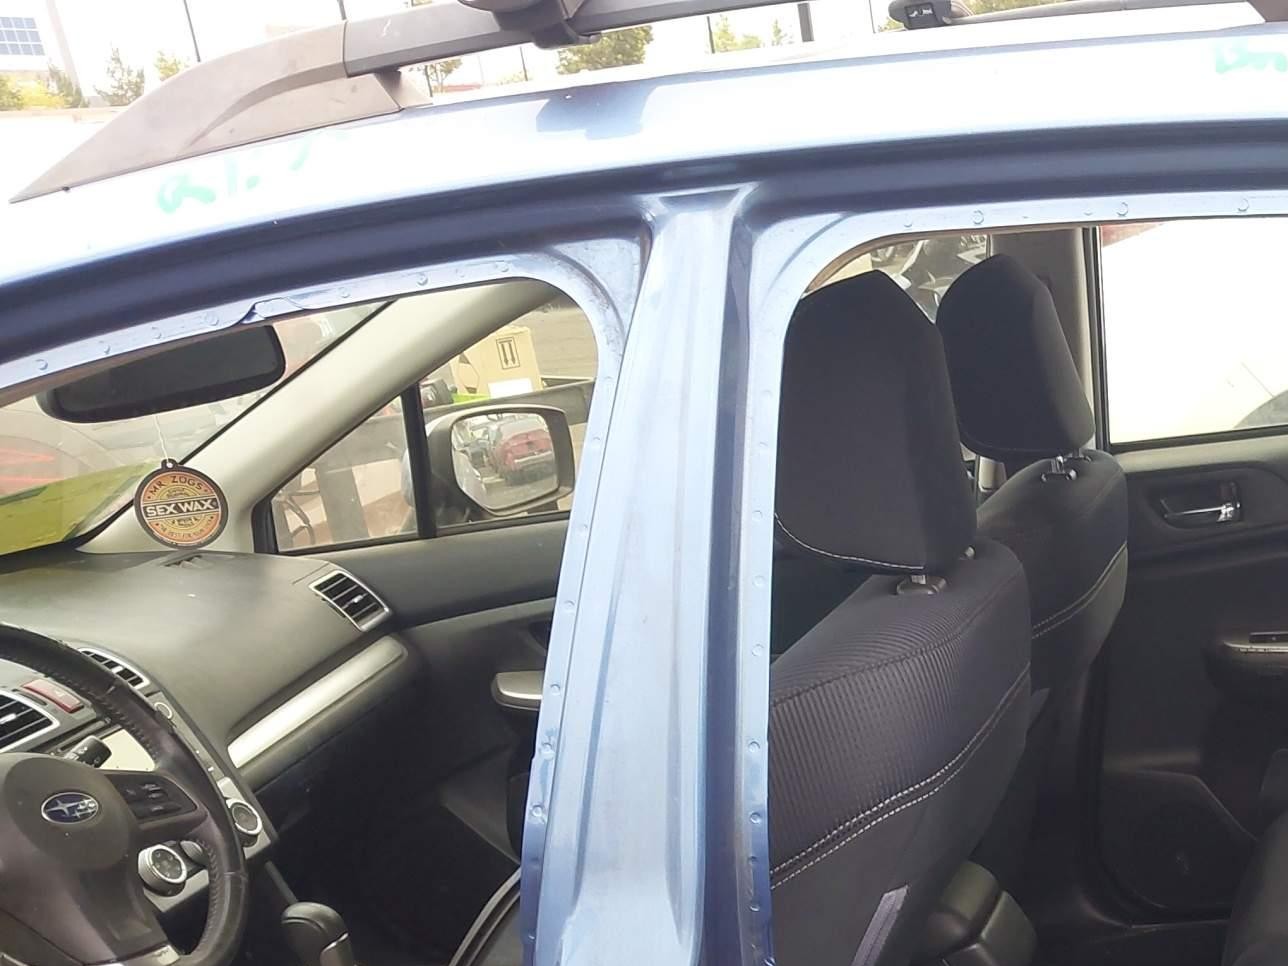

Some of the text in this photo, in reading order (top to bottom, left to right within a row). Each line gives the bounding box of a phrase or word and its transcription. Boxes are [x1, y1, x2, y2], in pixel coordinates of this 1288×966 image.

[149, 480, 166, 496] MR
[170, 475, 204, 490] ZOGS
[146, 499, 214, 517] SEX WAX
